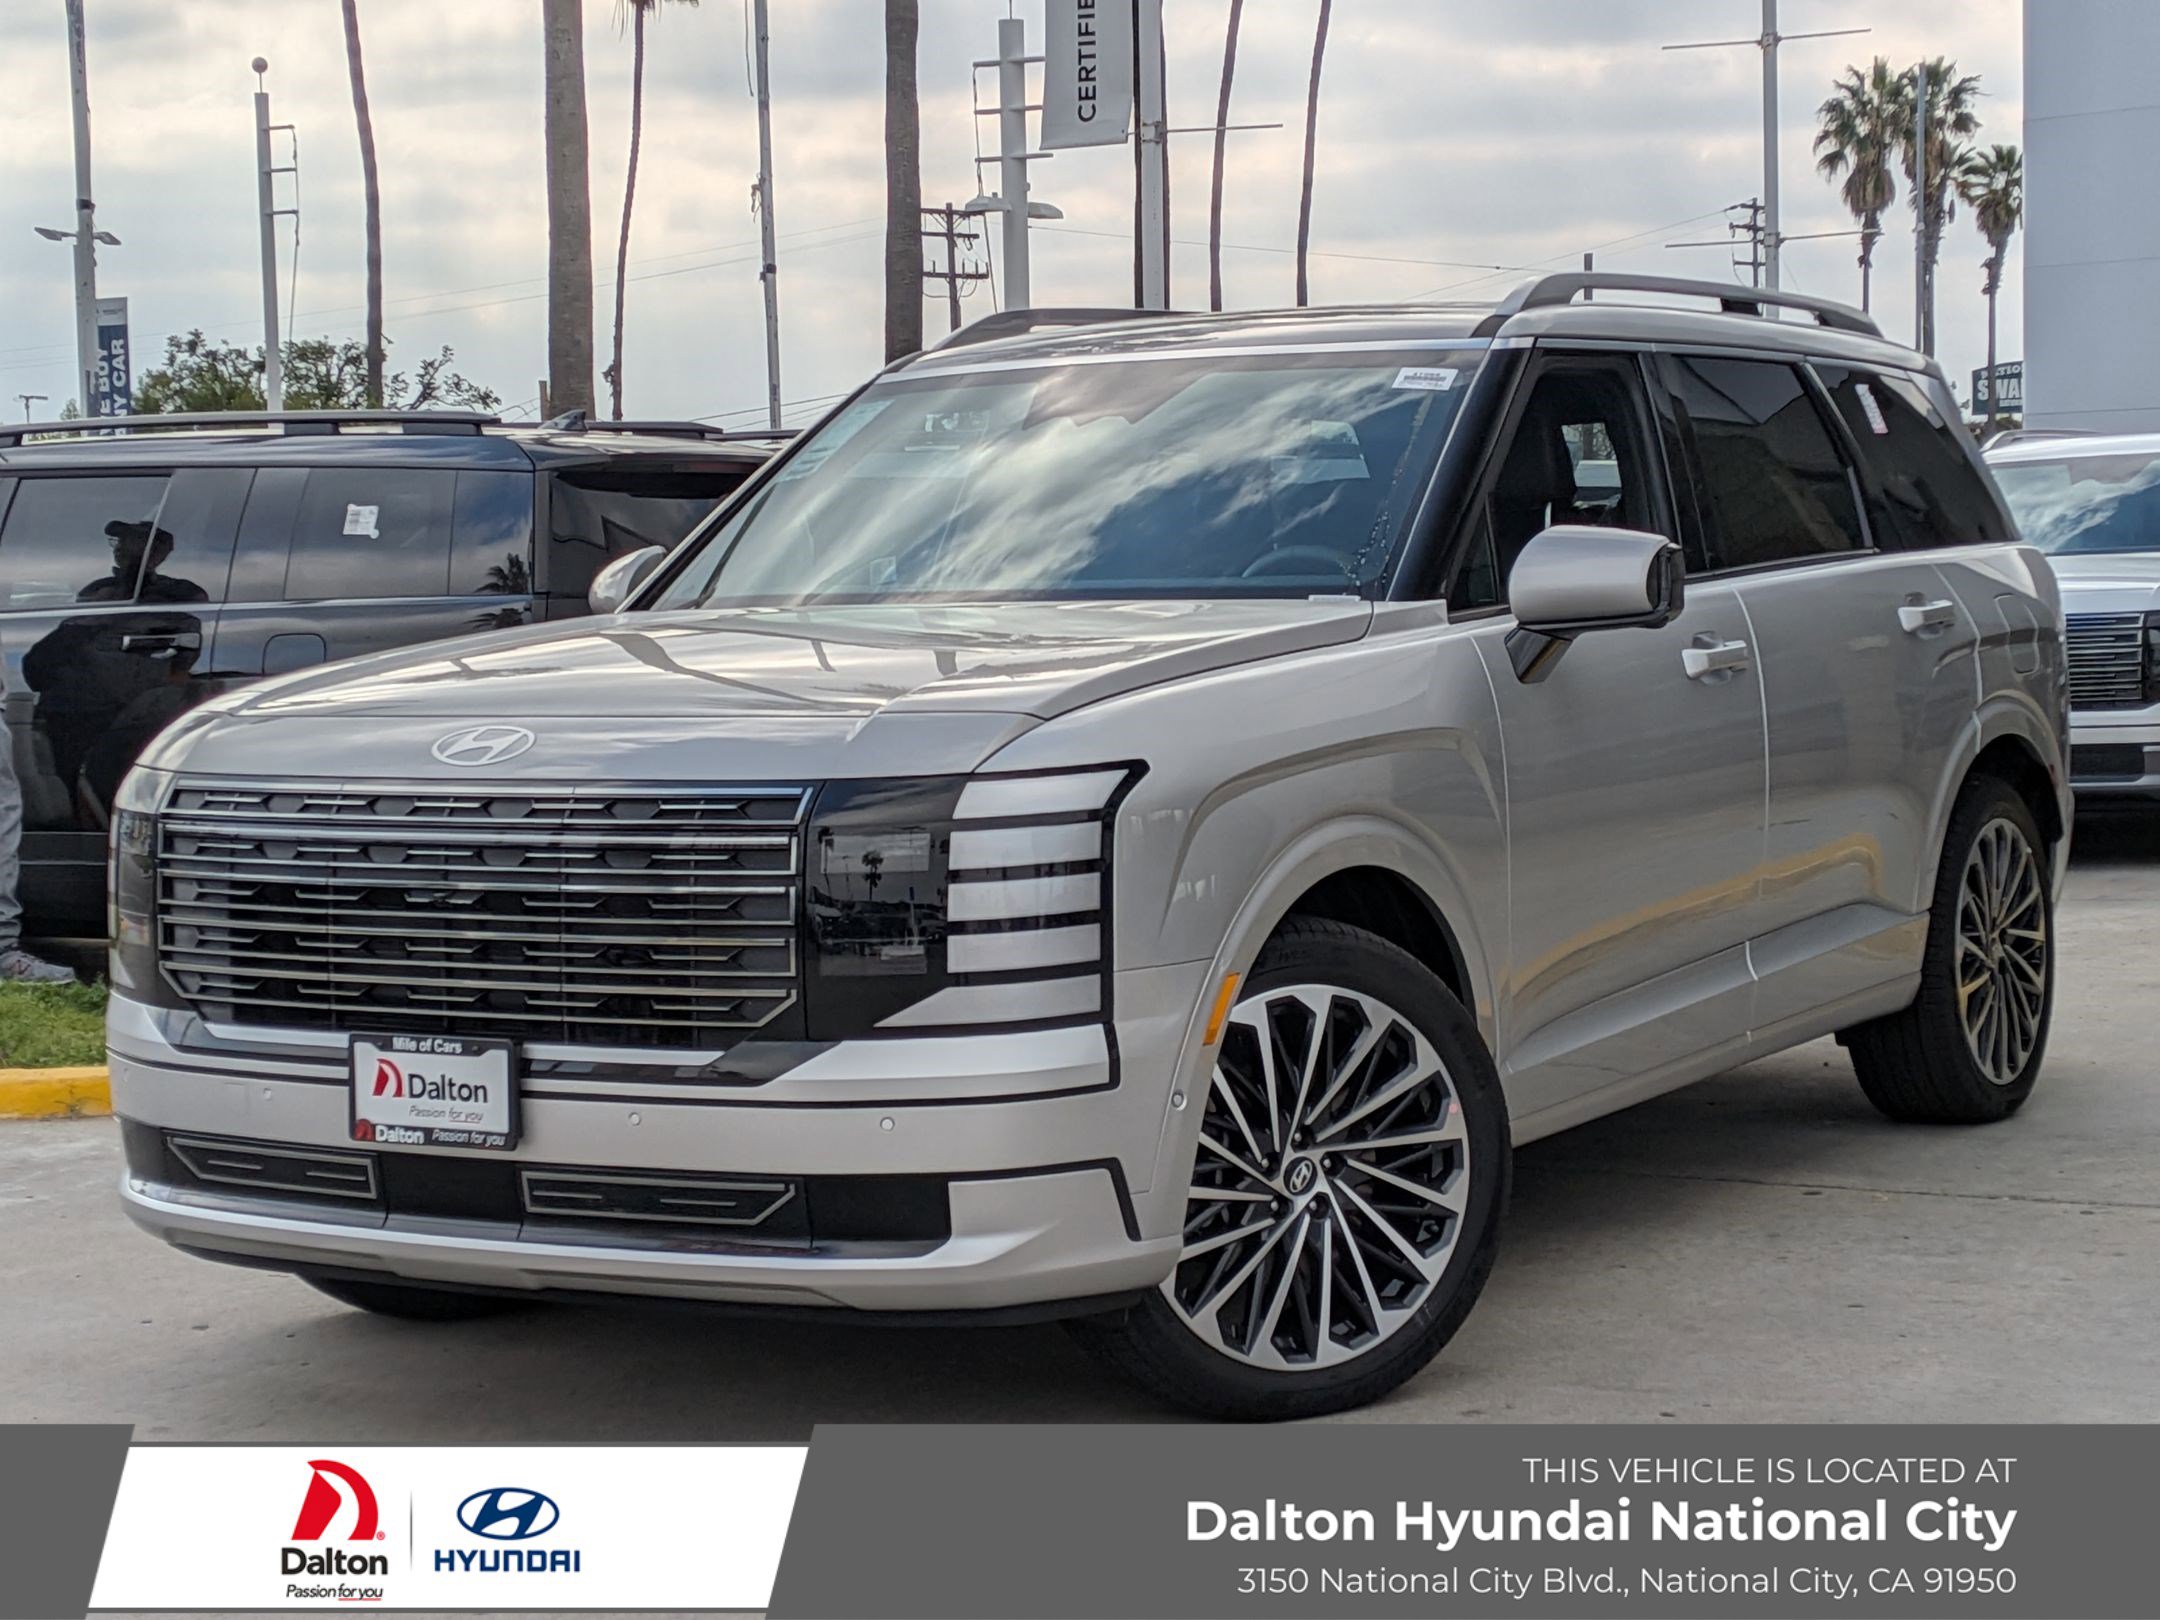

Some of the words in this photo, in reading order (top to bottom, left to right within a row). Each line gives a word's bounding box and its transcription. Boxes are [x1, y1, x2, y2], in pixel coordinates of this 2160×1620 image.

[98, 347, 110, 393] BUY
[111, 338, 127, 388] CAR
[392, 1037, 418, 1051] Mile
[419, 1037, 432, 1051] of
[433, 1038, 463, 1054] Cars
[408, 1073, 489, 1103] Dalton
[409, 1105, 446, 1118] Passion
[448, 1106, 463, 1121] for
[464, 1112, 485, 1122] you
[375, 1125, 425, 1144] Dalton
[432, 1129, 469, 1143] Passion
[470, 1133, 486, 1144] for
[485, 1136, 506, 1147] you
